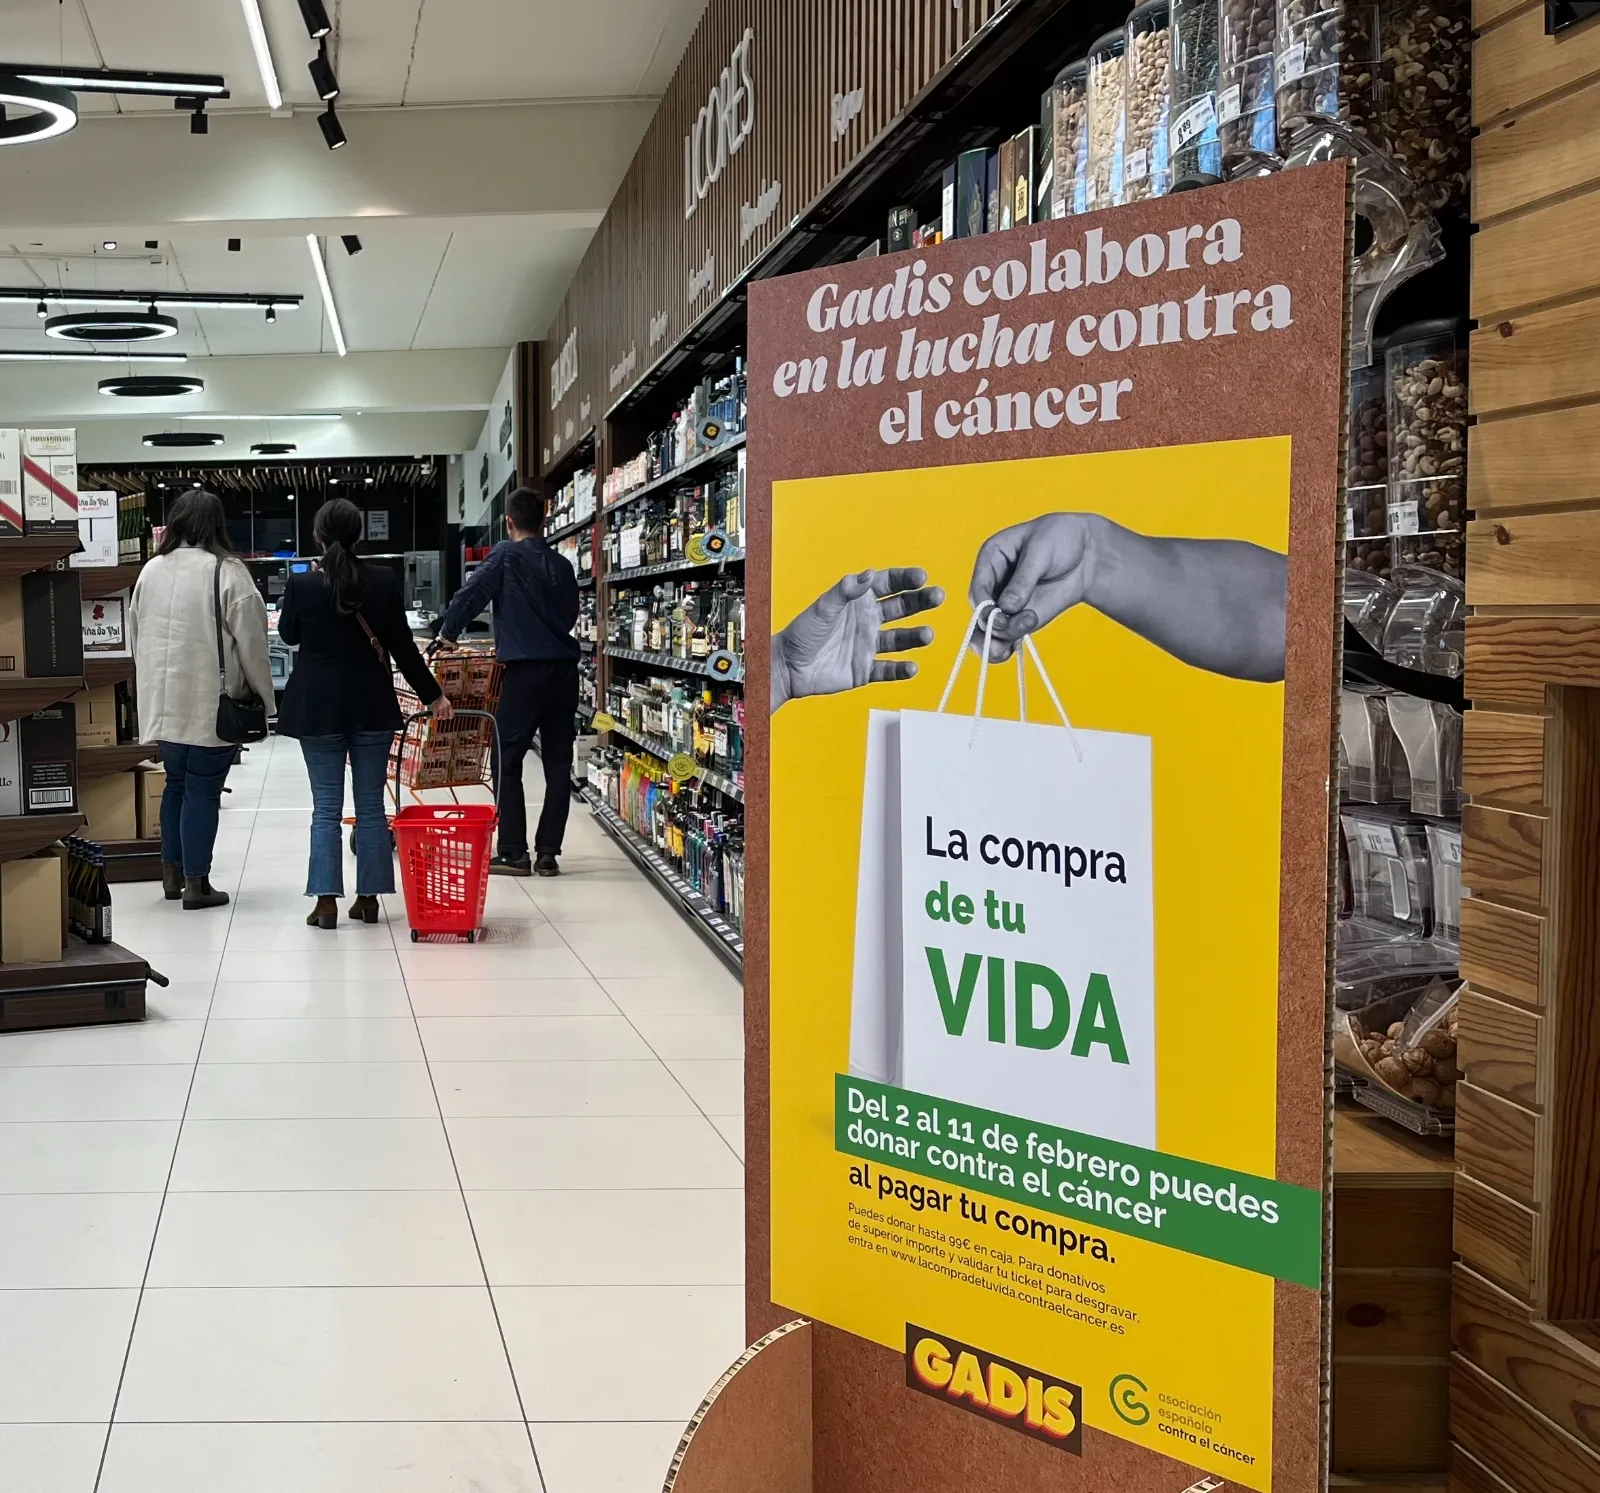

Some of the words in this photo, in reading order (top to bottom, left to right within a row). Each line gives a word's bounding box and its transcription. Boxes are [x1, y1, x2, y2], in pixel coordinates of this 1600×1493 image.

[806, 259, 954, 333] Gadis
[963, 218, 1244, 306] colabora
[772, 355, 828, 398] en
[837, 337, 888, 389] la
[896, 313, 1055, 382] lucha
[1066, 284, 1294, 357] contra
[879, 389, 923, 445] el
[934, 378, 1133, 440] cáncer
[926, 815, 969, 861] La
[979, 833, 1127, 888] compra
[925, 880, 975, 925] de
[984, 889, 1026, 934] tu
[924, 946, 1131, 1065] VIDA
[847, 1119, 921, 1160] donar
[926, 1145, 1015, 1188] contra
[1022, 1168, 1051, 1198] el
[1057, 1179, 1167, 1229] cáncer
[848, 1087, 889, 1122] Del
[895, 1105, 910, 1127] 2
[916, 1108, 941, 1135] al
[948, 1117, 975, 1145] 11
[982, 1123, 1019, 1155] de
[1026, 1132, 1140, 1187] febrero
[1149, 1169, 1280, 1224] puedes
[848, 1202, 885, 1223] Puedes
[887, 1215, 916, 1232] donar
[918, 1224, 946, 1243] hasta
[948, 1236, 971, 1250] 99€
[974, 1244, 988, 1256] en
[990, 1249, 1015, 1264] caja.
[1018, 1255, 1044, 1273] Para
[1047, 1266, 1106, 1294] donativos
[849, 1163, 872, 1190] al
[878, 1174, 952, 1212] pagar
[960, 1192, 987, 1225] tu
[994, 1209, 1116, 1264] compra.
[848, 1219, 860, 1231] de
[863, 1224, 903, 1243] superior
[905, 1235, 946, 1259] importe
[948, 1252, 955, 1263] y
[957, 1255, 994, 1274] validar
[997, 1265, 1008, 1279] tu
[1011, 1271, 1043, 1291] ticket
[1046, 1283, 1072, 1300] para
[1075, 1292, 1140, 1323] desgravar.
[848, 1235, 874, 1250] entra
[875, 1244, 888, 1255] en
[891, 1249, 1125, 1335] www.lacompradetuvida.contraelcancer.es
[911, 1337, 1076, 1440] GADIS
[1158, 1393, 1222, 1423] asociación
[1158, 1407, 1213, 1435] española
[1158, 1422, 1197, 1444] contra
[1199, 1436, 1210, 1449] el
[1213, 1443, 1256, 1465] cáncer
